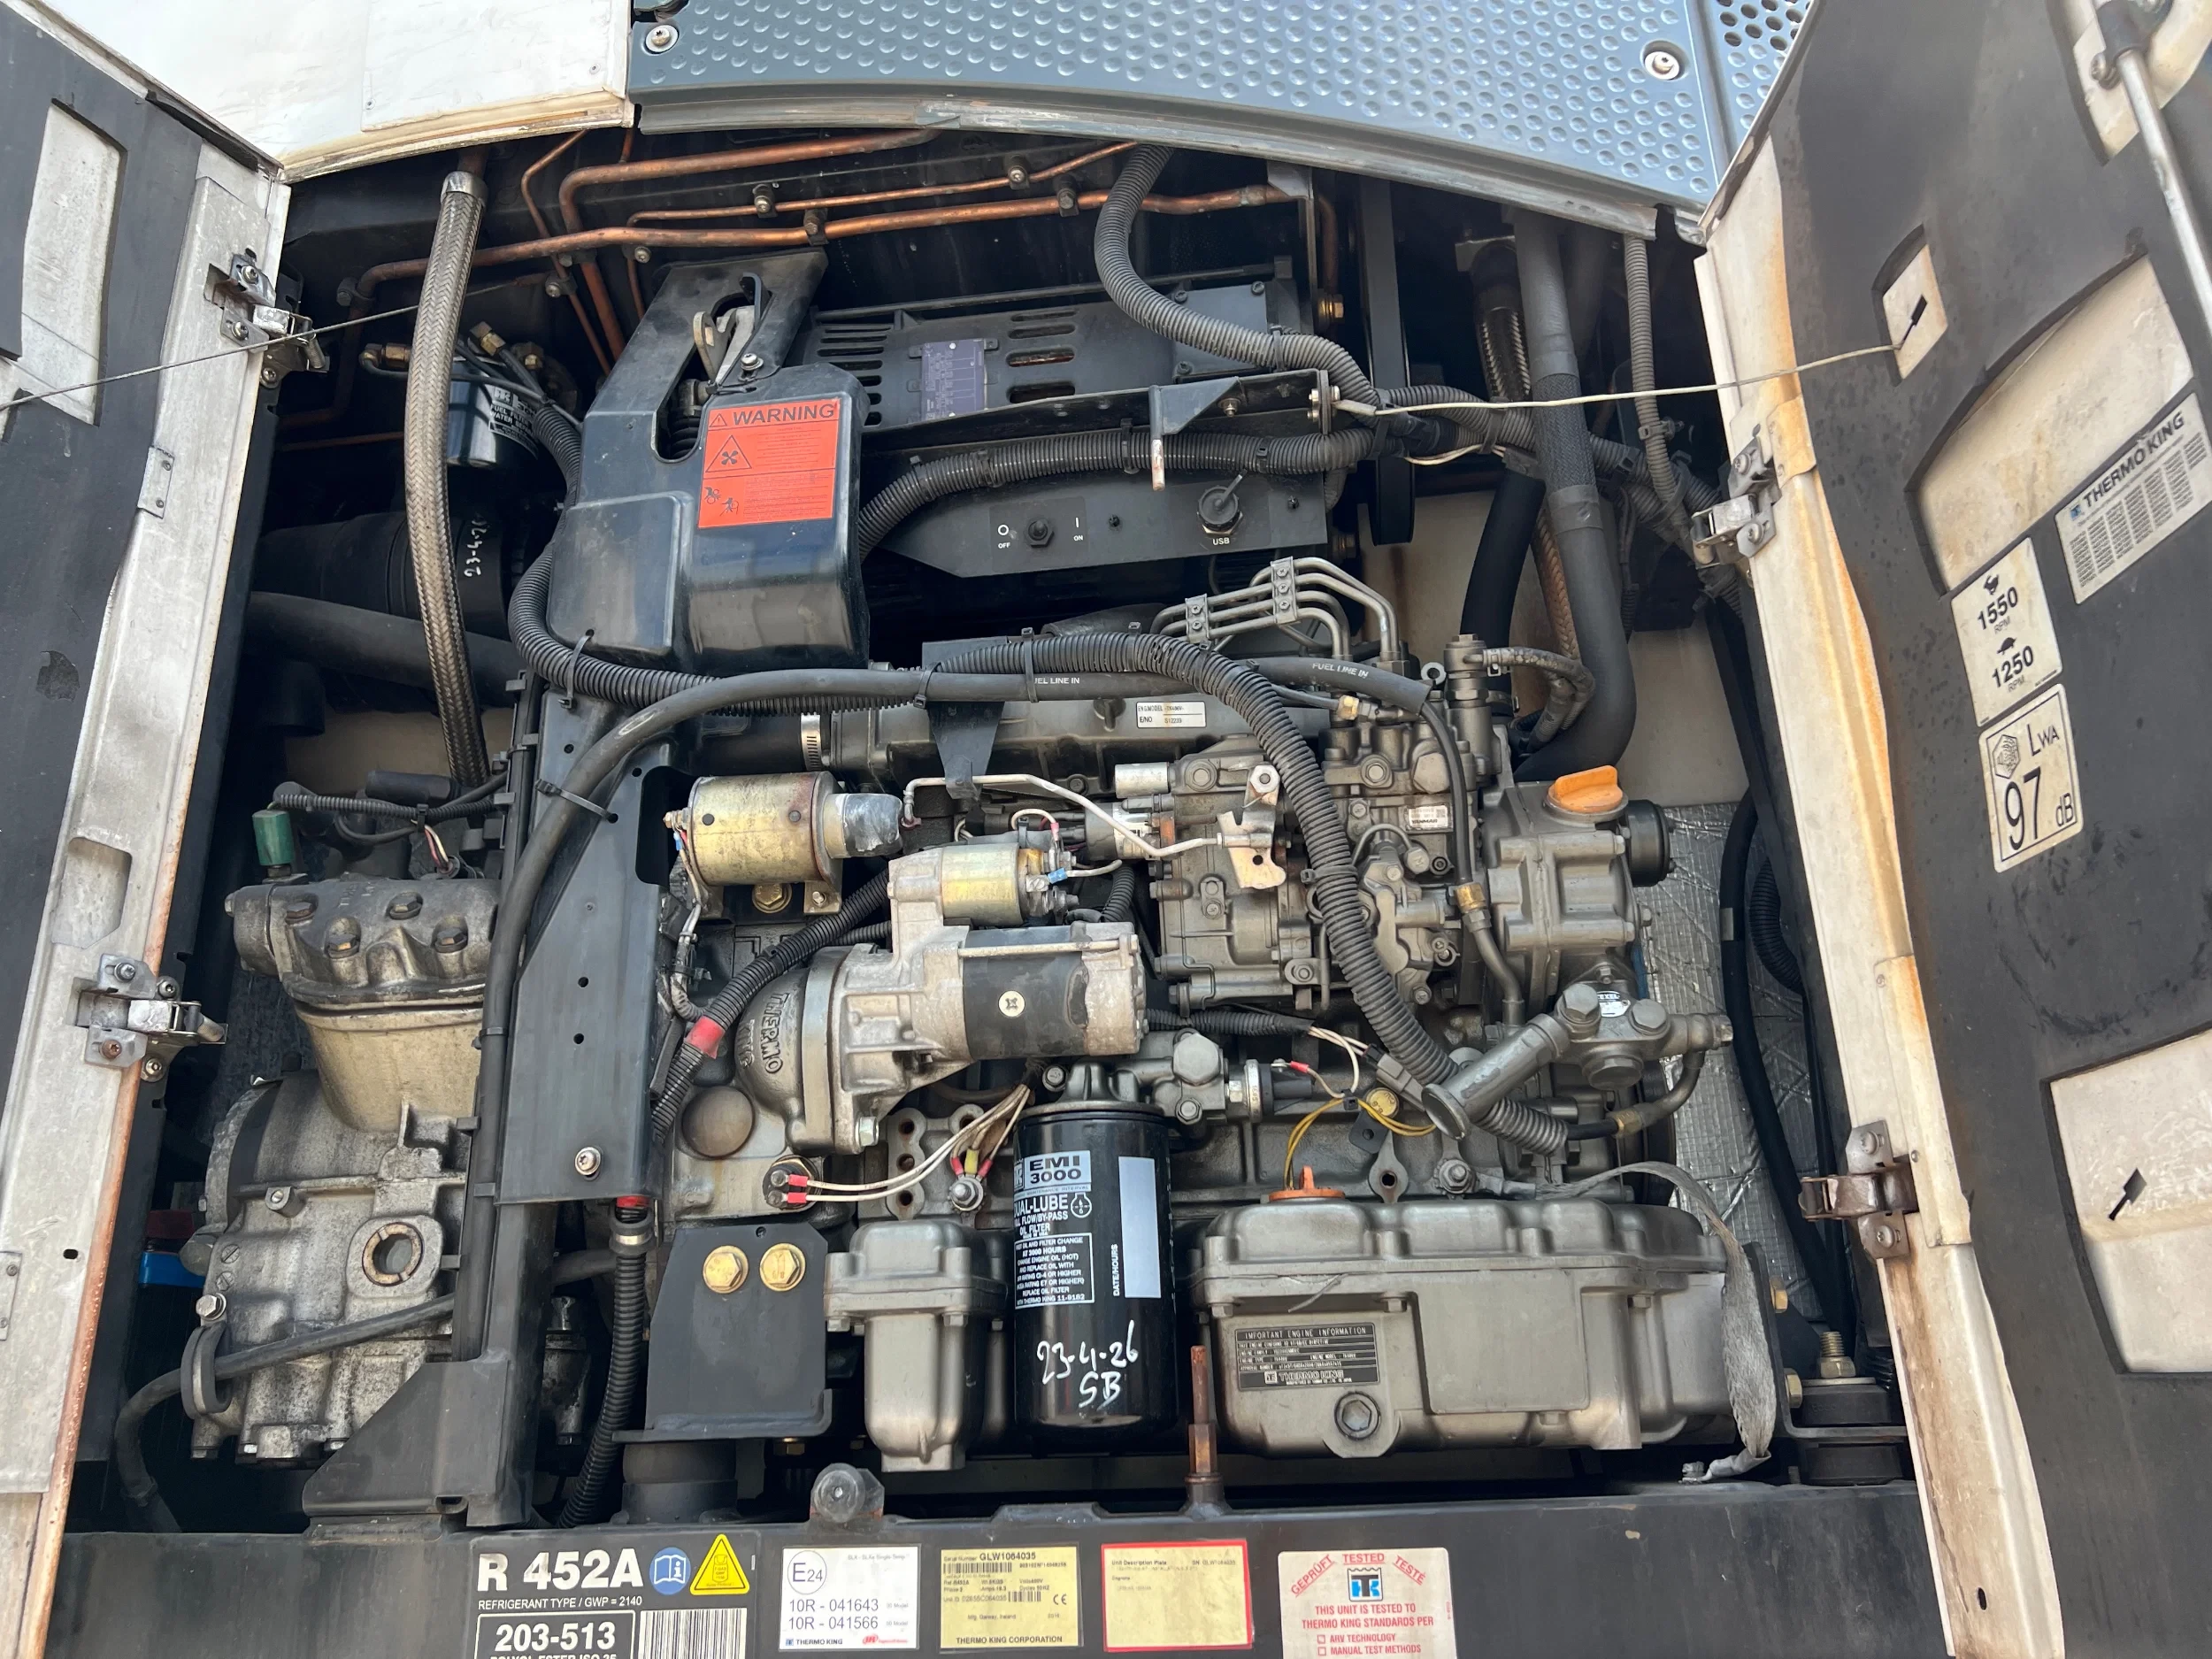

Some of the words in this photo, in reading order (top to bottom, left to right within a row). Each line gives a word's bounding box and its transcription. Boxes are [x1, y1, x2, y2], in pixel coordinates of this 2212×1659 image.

[733, 403, 834, 426] WARNING
[2083, 447, 2147, 507] THERMO
[2148, 411, 2185, 455] KING
[1212, 537, 1230, 546] USB
[1977, 587, 2018, 630] 1550
[1993, 616, 2012, 634] RPM
[1312, 663, 1335, 672] FUEL
[1992, 645, 2034, 688] 1250
[2008, 674, 2025, 693] RPM
[2005, 766, 2041, 850] 97
[2055, 793, 2074, 827] dB
[761, 992, 790, 1073] THERMO
[1030, 1156, 1080, 1171] EMI
[1030, 1168, 1081, 1184] 3000
[1029, 1222, 1050, 1234] FILTER
[1111, 1244, 1120, 1297] DATE/HOURS
[1245, 1330, 1283, 1340] IMPORTANT
[1287, 1328, 1313, 1338] ENGINE
[1318, 1326, 1366, 1336] INFORMATION
[1079, 1371, 1121, 1411] SB
[478, 1553, 508, 1591] R
[523, 1548, 643, 1590] 452A
[1342, 1553, 1385, 1563] TESTED
[1395, 1555, 1426, 1582] TESTÉ
[478, 1598, 548, 1609] REFRIGERANT
[550, 1597, 576, 1609] TYPE
[585, 1596, 608, 1607] GWP
[619, 1595, 642, 1607] 2140
[789, 1599, 816, 1612] 10R
[829, 1598, 879, 1612] 041643
[1315, 1605, 1334, 1615] THIS
[1338, 1604, 1357, 1614] UNIT
[1360, 1604, 1368, 1614] IS
[1371, 1603, 1402, 1613] TESTED
[1404, 1602, 1416, 1612] TO
[788, 1617, 815, 1630] 10R
[828, 1616, 879, 1630] 041566
[1302, 1618, 1338, 1629] THERMO
[1340, 1617, 1361, 1628] KING
[1363, 1617, 1415, 1627] STANDARDS
[1417, 1616, 1434, 1625] PER
[495, 1622, 616, 1652] 203-513
[1348, 1633, 1395, 1642] TECHNOLOGY
[1331, 1646, 1363, 1655] MANUAL
[1365, 1645, 1383, 1654] TEST
[1386, 1644, 1422, 1654] METHODS
